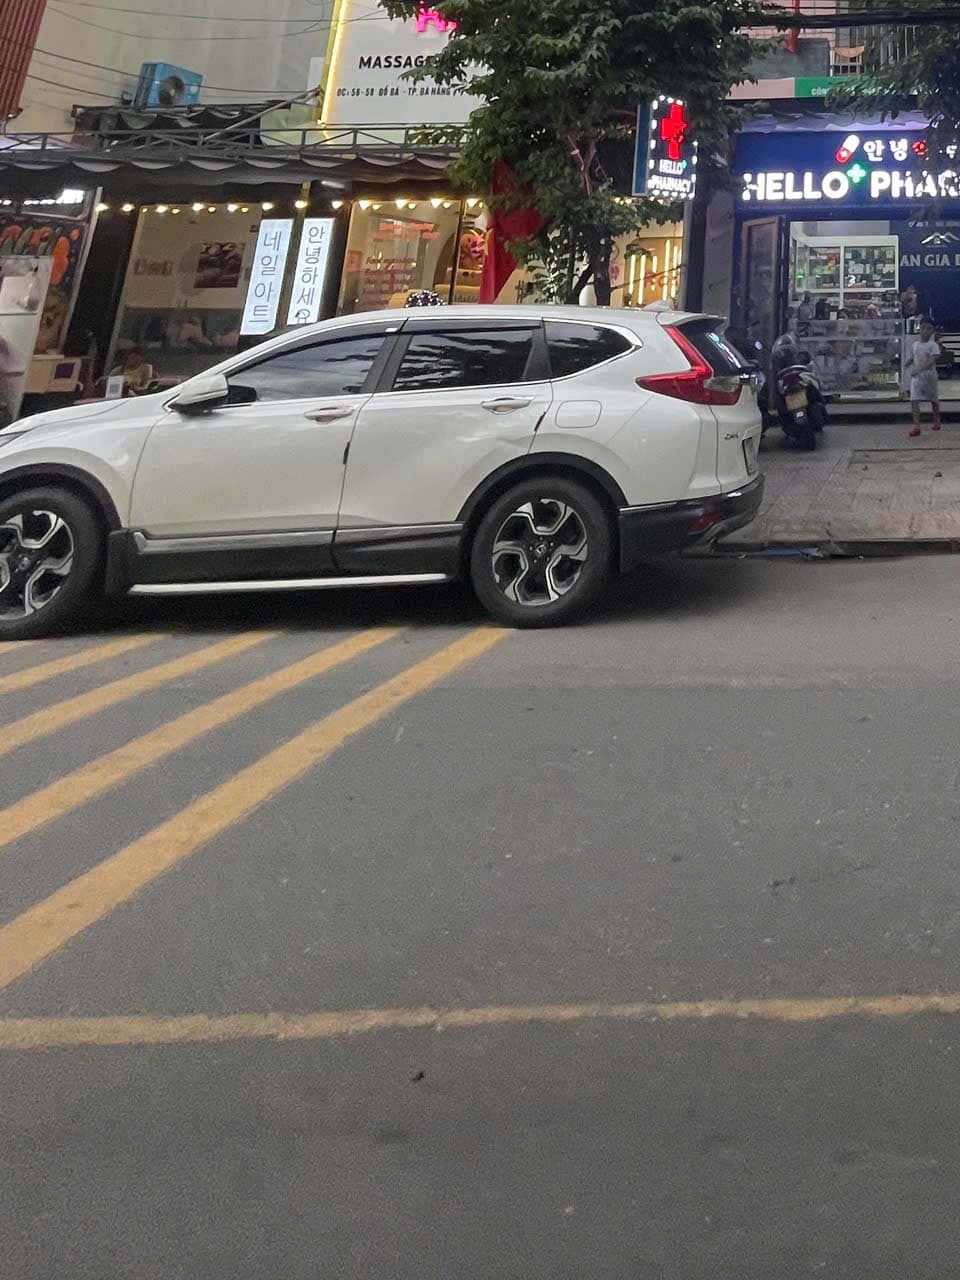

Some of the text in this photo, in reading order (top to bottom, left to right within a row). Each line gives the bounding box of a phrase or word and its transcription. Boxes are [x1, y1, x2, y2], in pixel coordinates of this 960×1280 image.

[359, 56, 427, 69] MASSAG
[659, 159, 684, 175] HELLO
[650, 174, 691, 193] PHARMACY
[742, 171, 849, 201] HELLO
[924, 253, 950, 266] GIA
[248, 230, 283, 323] 네일아트
[294, 225, 326, 325] 안녕하세요
